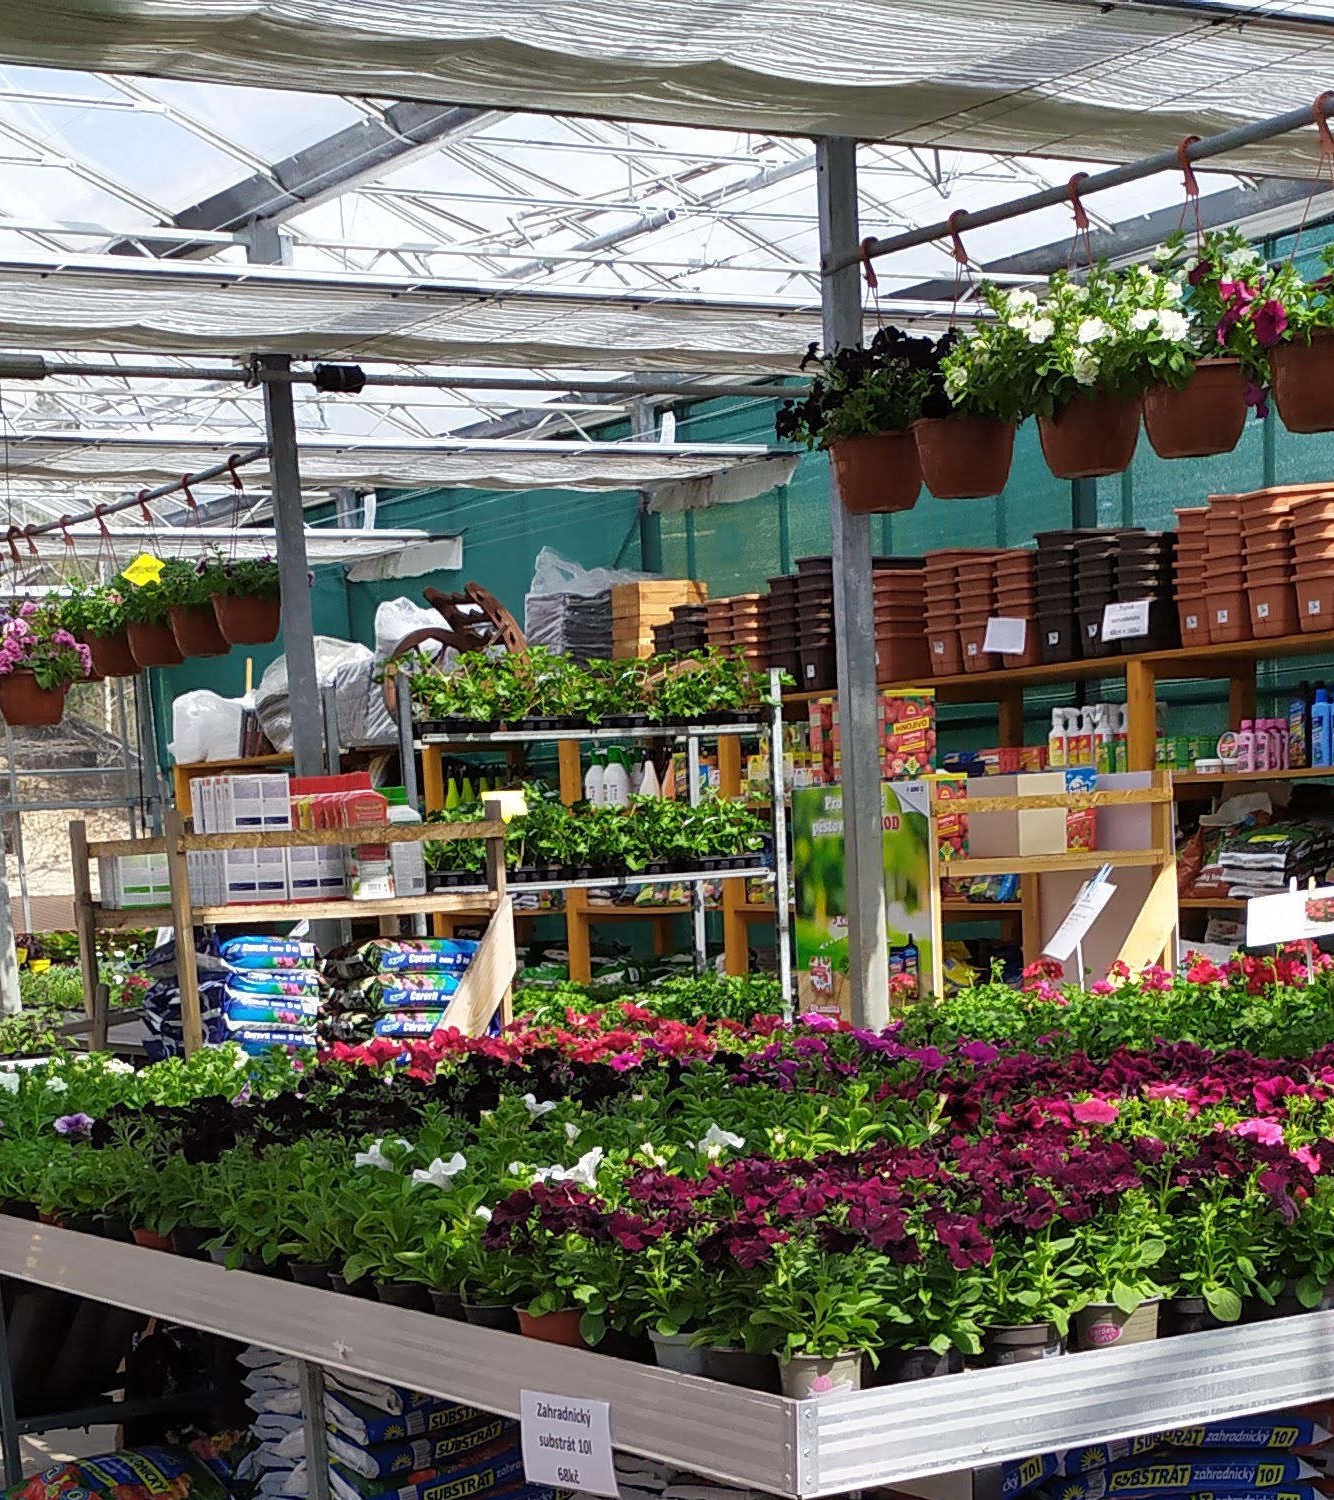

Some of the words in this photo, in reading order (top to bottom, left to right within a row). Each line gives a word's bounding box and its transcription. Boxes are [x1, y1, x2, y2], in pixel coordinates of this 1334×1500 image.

[895, 718, 929, 732] HNOJIVO
[408, 953, 436, 965] Cererit
[456, 954, 462, 965] 5
[410, 990, 439, 1002] Cererit
[537, 1402, 592, 1428] Zahradnický
[539, 1433, 576, 1453] substrát
[1205, 1430, 1271, 1446] zahradnický
[557, 1466, 581, 1485] 68kč
[1193, 1468, 1255, 1483] zahradnický
